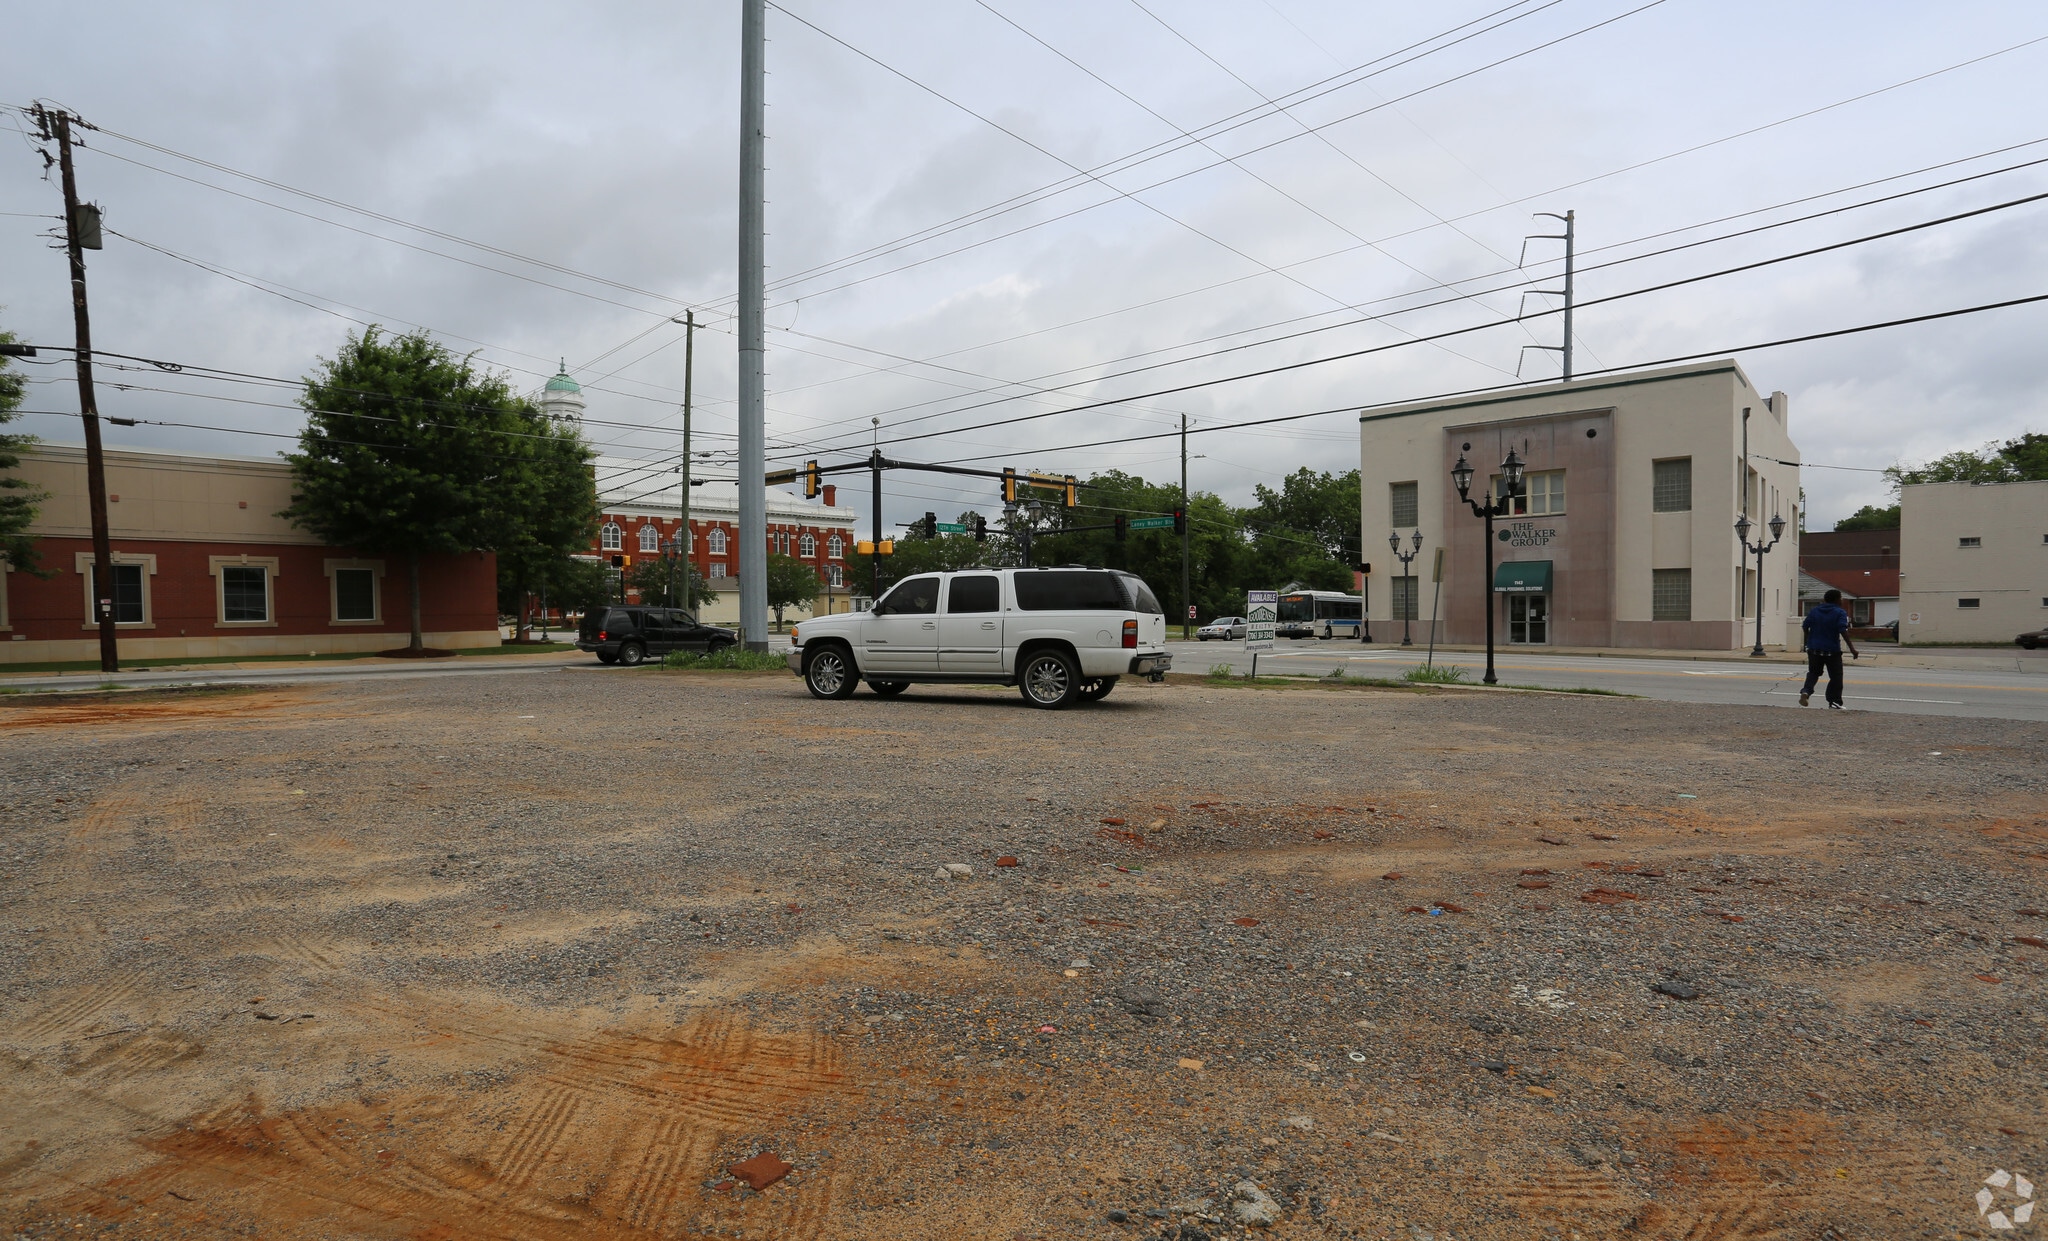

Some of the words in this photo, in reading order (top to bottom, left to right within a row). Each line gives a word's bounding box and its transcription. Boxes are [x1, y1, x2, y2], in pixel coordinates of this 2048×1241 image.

[1511, 522, 1534, 530] THE
[1511, 529, 1556, 539] WALKER
[1511, 537, 1549, 547] GROUP
[1250, 594, 1276, 602] AVAILABLE
